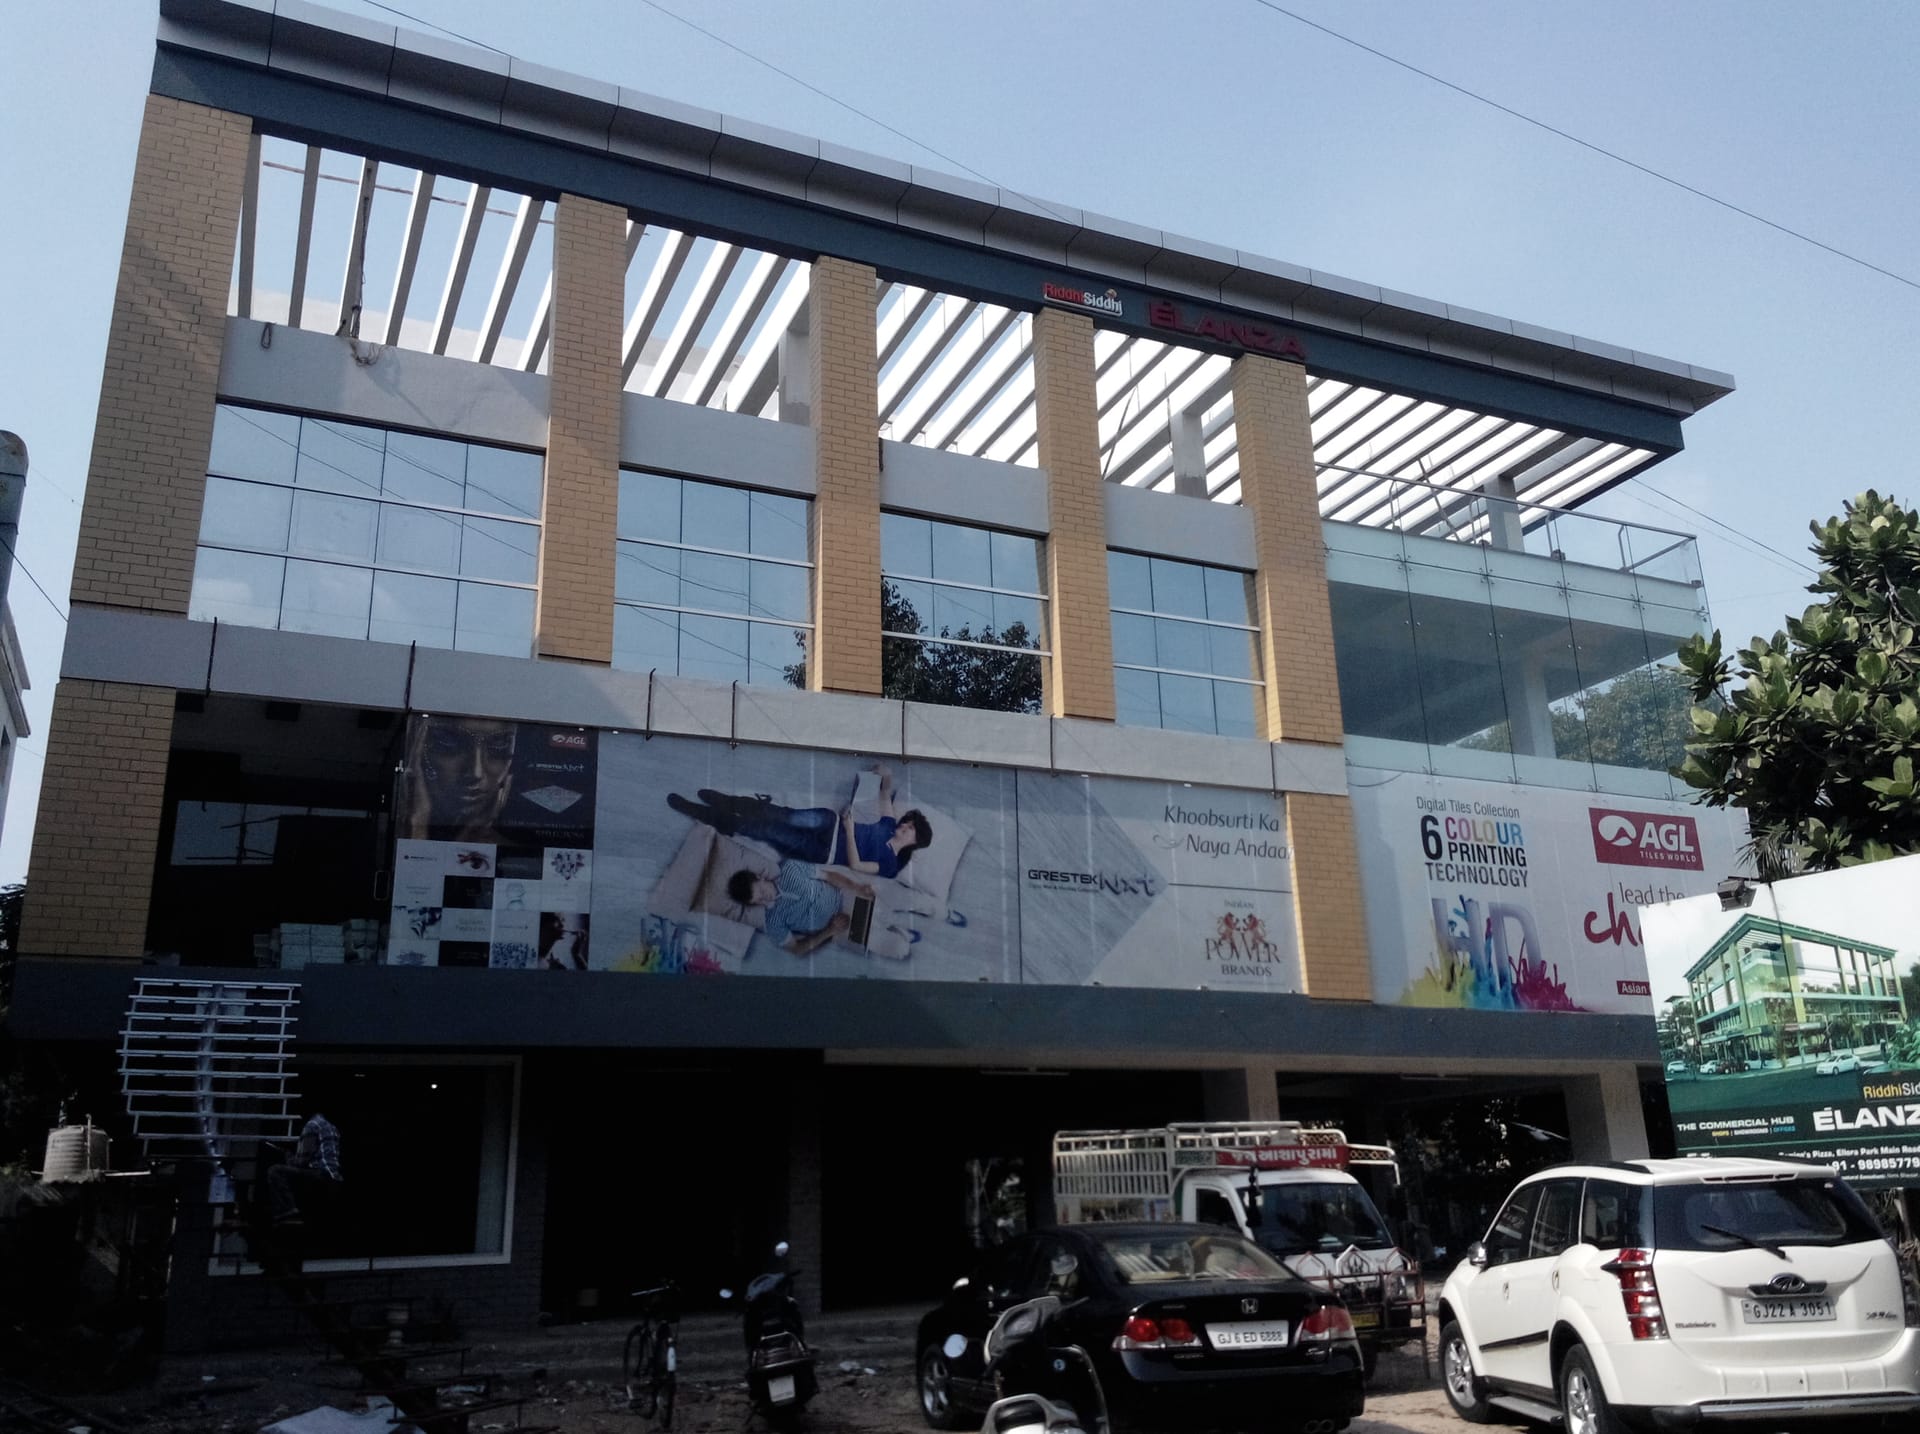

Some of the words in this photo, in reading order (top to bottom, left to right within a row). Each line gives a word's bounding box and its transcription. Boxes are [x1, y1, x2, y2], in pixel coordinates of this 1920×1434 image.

[1164, 805, 1254, 830] Khoobsurti
[1259, 812, 1279, 832] Ka
[1416, 796, 1447, 813] Digital
[1448, 799, 1472, 814] Tiles
[1474, 801, 1520, 818] Collection
[1187, 833, 1230, 859] Naya
[1420, 814, 1443, 861] 6
[1445, 816, 1524, 846] COLOUR
[1639, 822, 1694, 852] AGL
[1447, 841, 1527, 867] PRINTING
[1640, 850, 1665, 860] TILES
[1667, 852, 1697, 863] WORLD
[1028, 869, 1098, 885] GRESTEK
[1425, 862, 1528, 888] TECHNOLOGY
[1619, 882, 1655, 905] lead
[1584, 891, 1643, 947] ch
[1205, 932, 1281, 964] POWER
[1221, 963, 1273, 977] BRANDS
[1621, 983, 1648, 994] Asian
[1677, 1122, 1697, 1132] THE
[1699, 1118, 1769, 1130] COMMERCIAL
[1770, 1116, 1794, 1126] HUB
[1860, 1147, 1879, 1156] Park
[1880, 1145, 1900, 1155] Main
[1789, 1302, 1796, 1317] A
